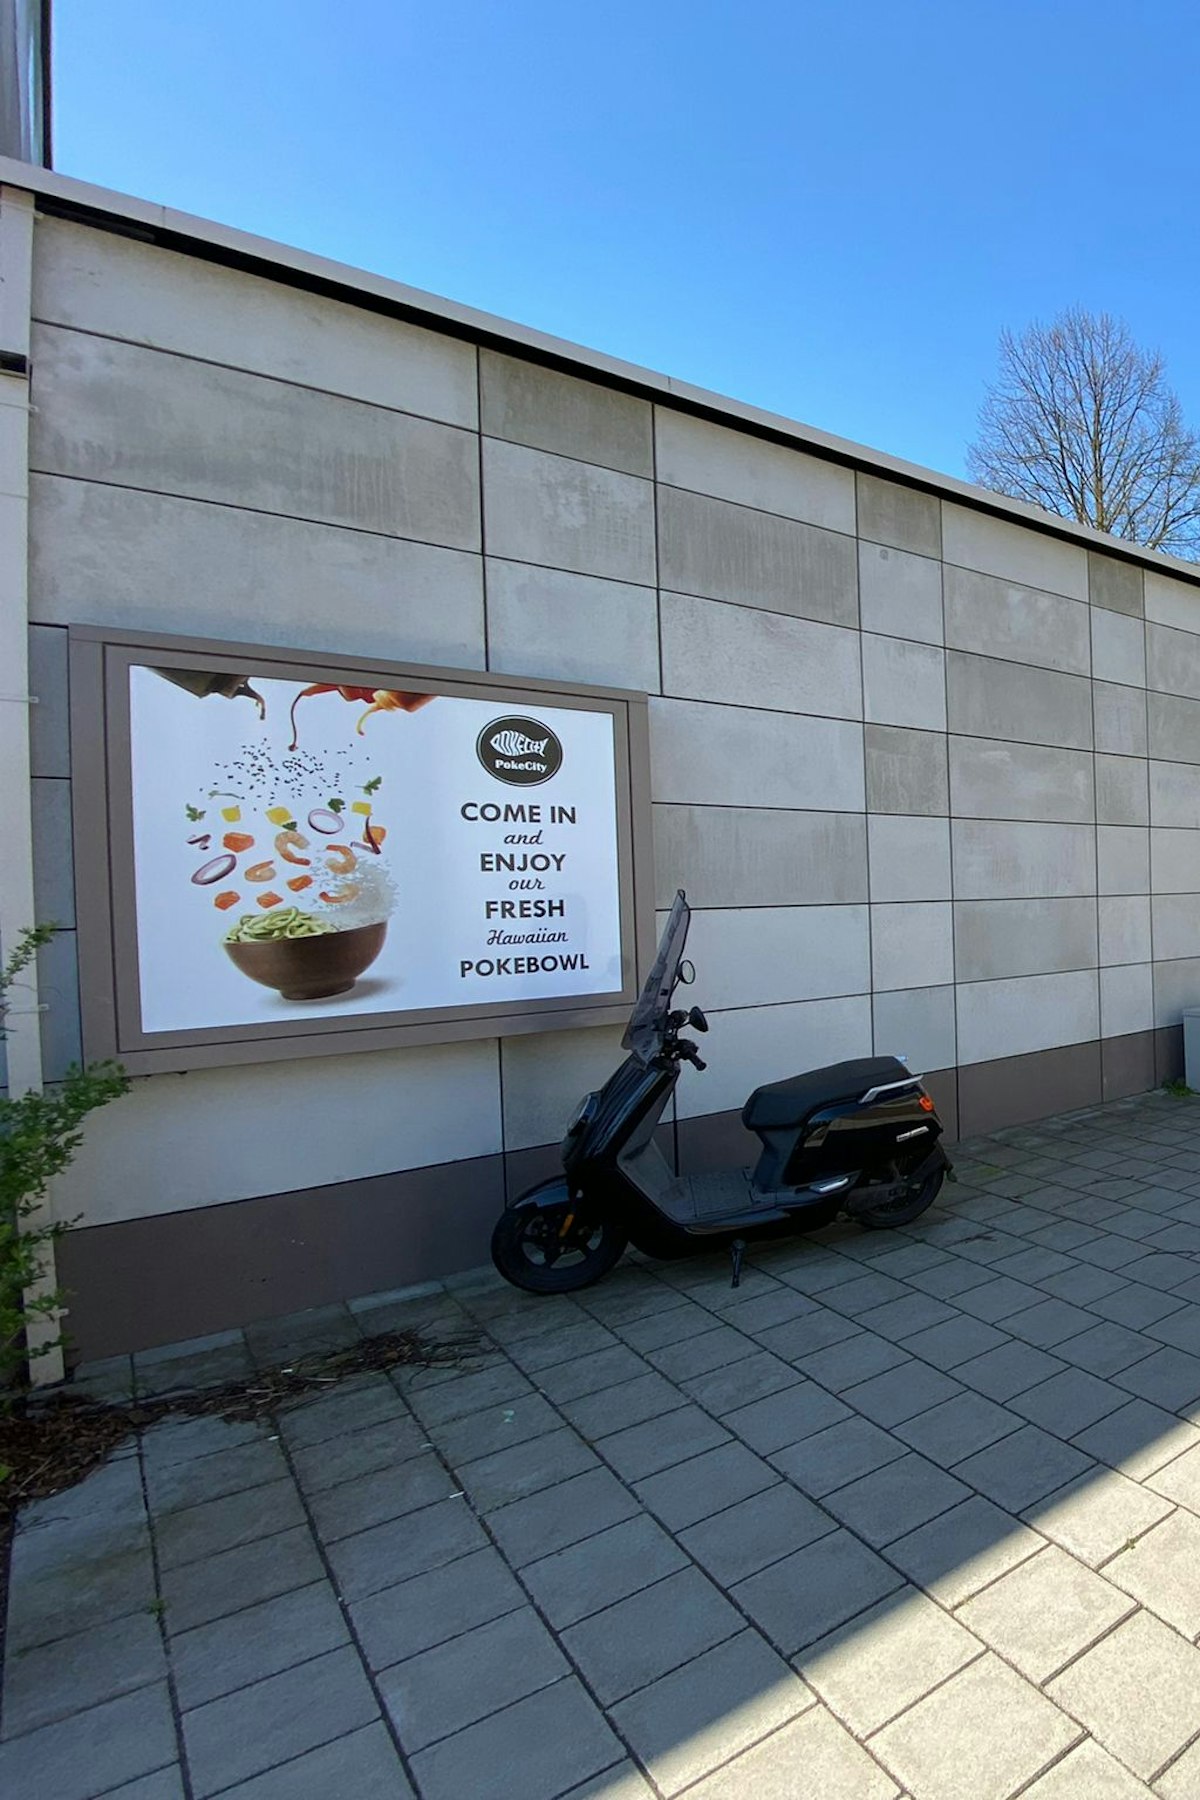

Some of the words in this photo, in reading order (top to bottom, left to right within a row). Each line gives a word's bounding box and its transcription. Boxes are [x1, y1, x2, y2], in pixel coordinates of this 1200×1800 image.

[495, 760, 547, 773] PokeCity
[461, 803, 540, 822] COME
[551, 807, 576, 823] IN
[504, 830, 544, 845] and
[480, 854, 566, 871] ENJOY
[509, 878, 545, 890] our
[486, 900, 564, 919] FRESH
[487, 928, 568, 946] Hawaiian
[461, 954, 589, 977] POKEBOWL
